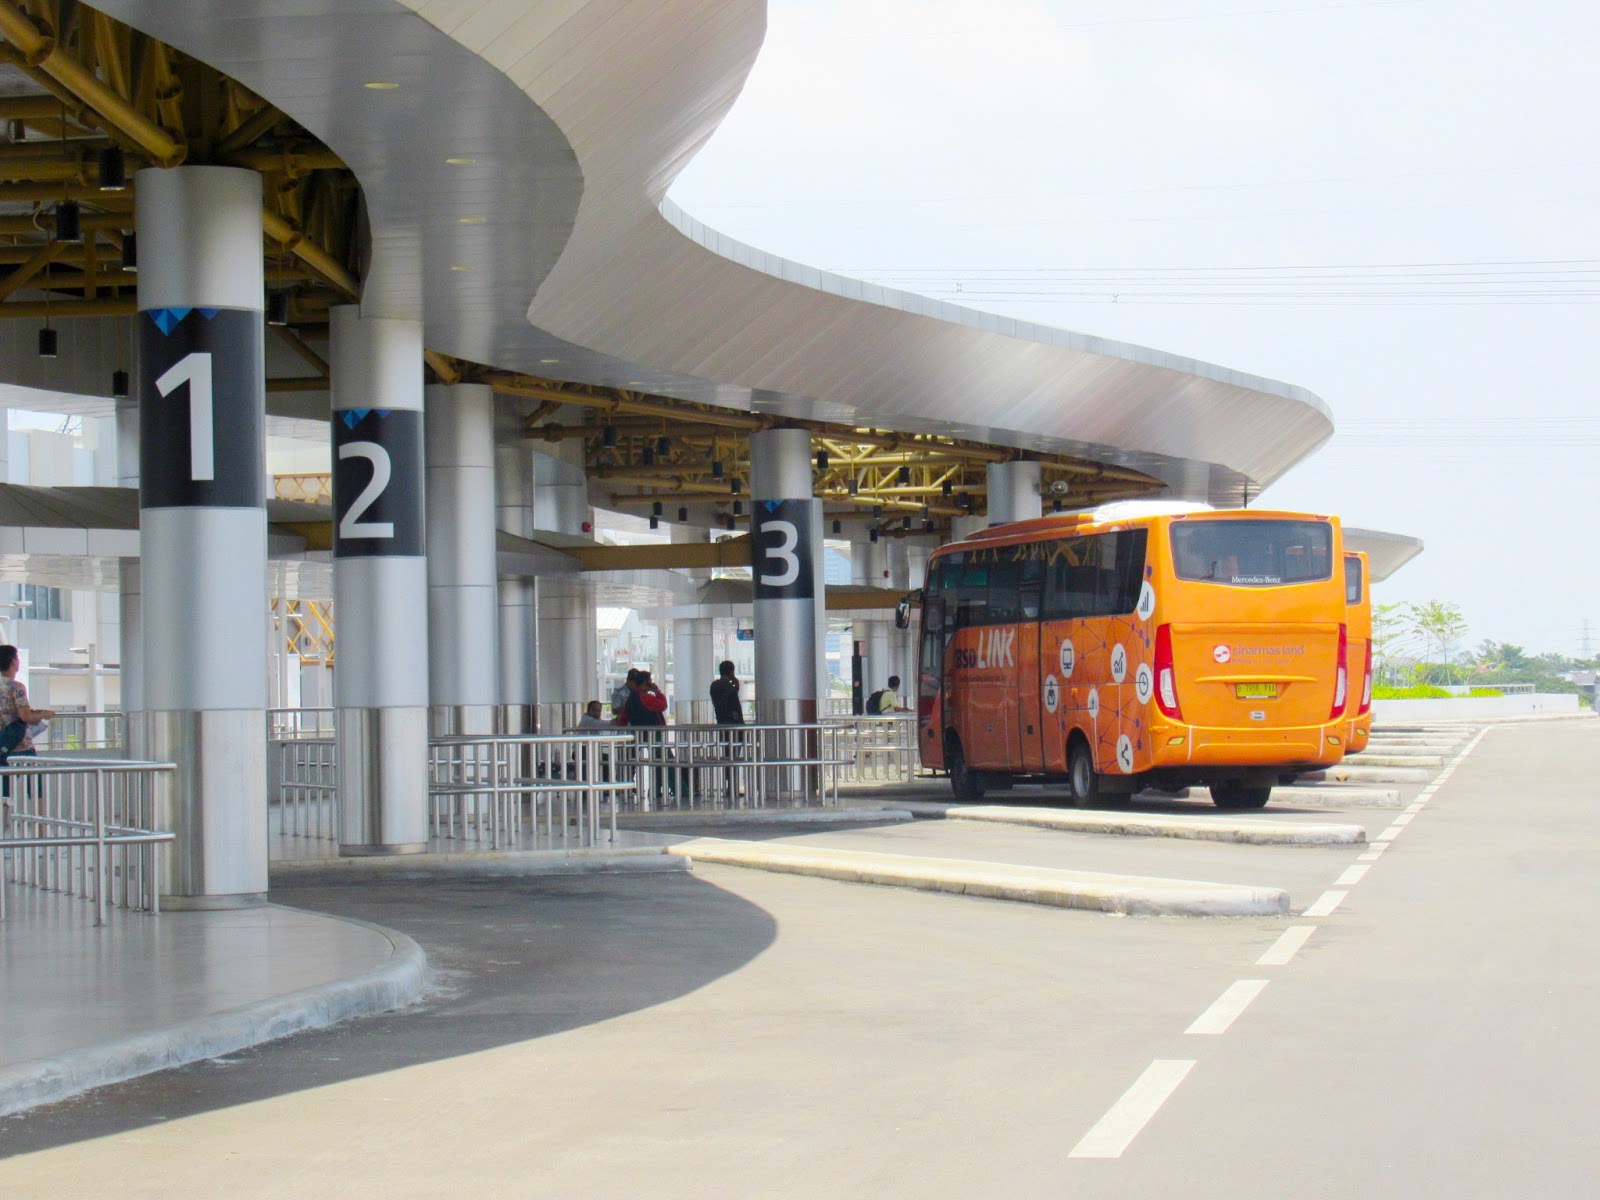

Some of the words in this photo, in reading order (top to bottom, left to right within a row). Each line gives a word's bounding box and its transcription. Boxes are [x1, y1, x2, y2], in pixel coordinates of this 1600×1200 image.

[155, 352, 215, 481] 1
[338, 440, 395, 540] 2
[760, 520, 800, 587] 3
[1231, 575, 1281, 584] Mercedes-Benz
[955, 647, 977, 669] BSD
[977, 627, 1015, 669] LINK
[1232, 645, 1281, 655] sinarmas
[1282, 645, 1305, 655] land
